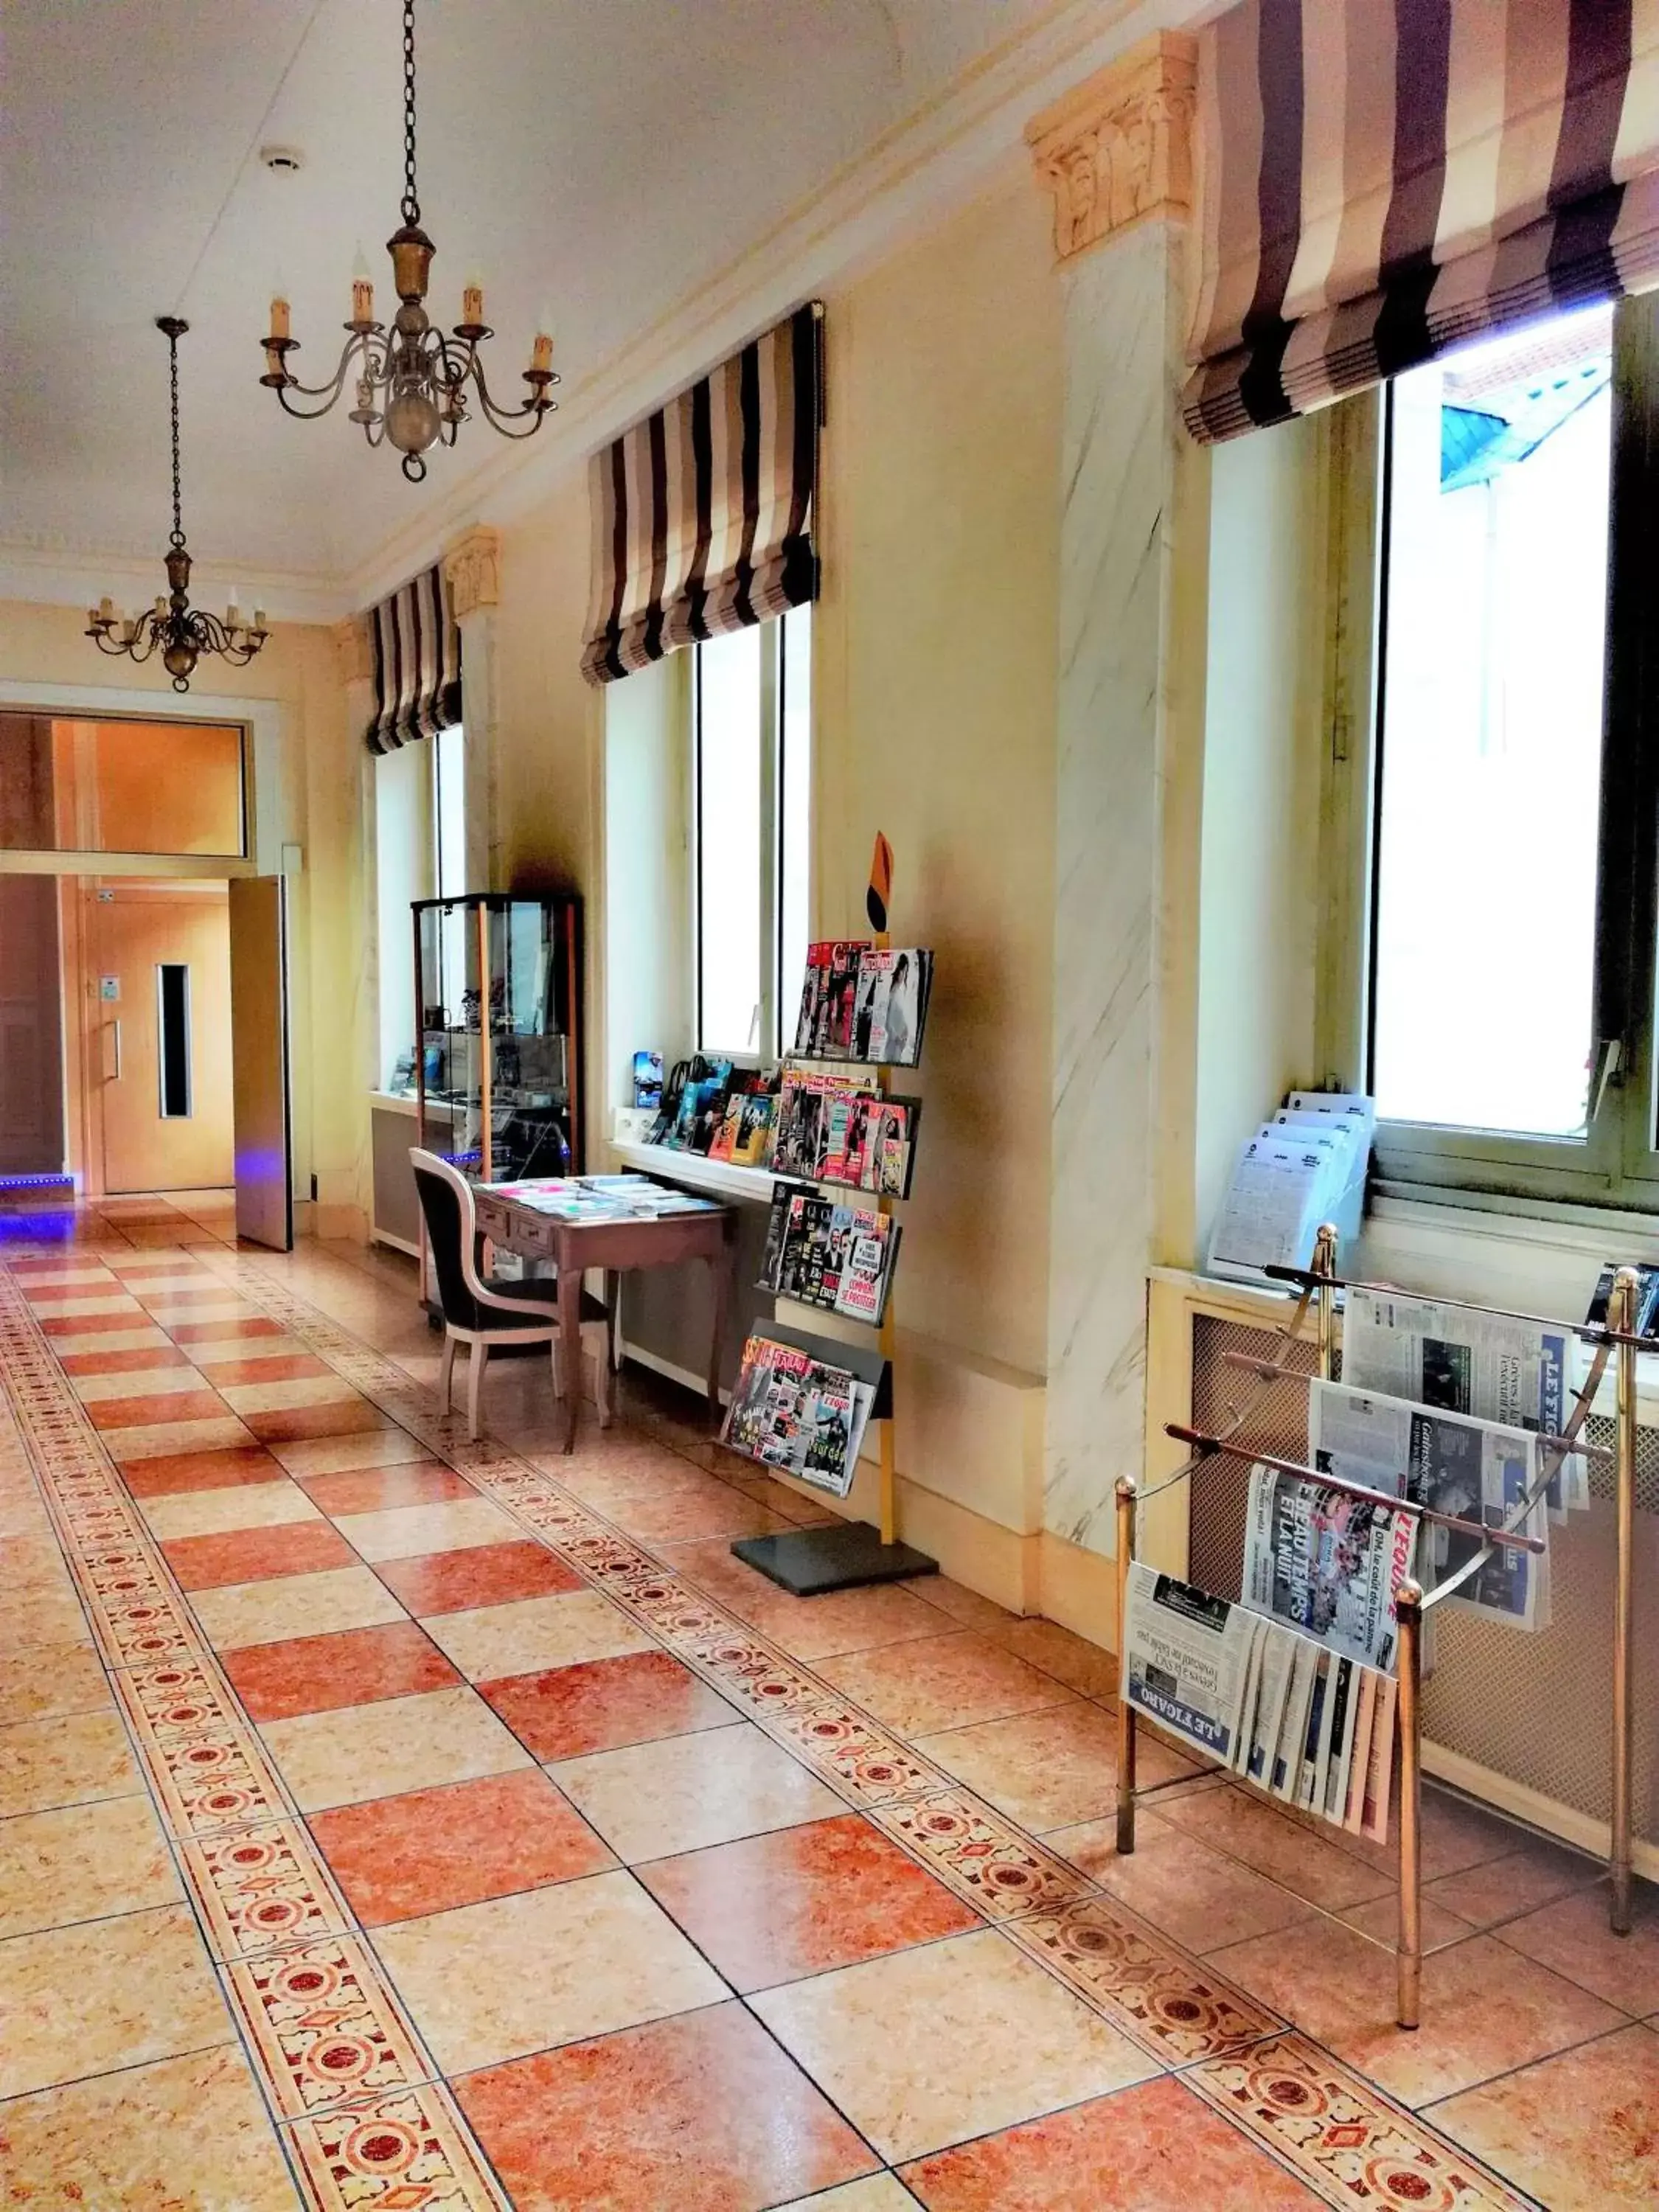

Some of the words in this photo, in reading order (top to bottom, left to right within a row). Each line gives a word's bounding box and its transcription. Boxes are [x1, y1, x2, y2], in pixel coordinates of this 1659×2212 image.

[1545, 1363, 1559, 1393] LE
[1416, 1422, 1433, 1503] Gainsbourg
[1281, 1495, 1295, 1520] ET
[1279, 1519, 1294, 1539] LA
[1293, 1497, 1312, 1555] BEAU
[1374, 1531, 1384, 1552] OM,
[1276, 1542, 1293, 1585] NUIT
[1374, 1554, 1382, 1565] le
[1291, 1554, 1309, 1624] TEMPS
[1371, 1565, 1381, 1590] coût
[1369, 1591, 1378, 1605] de
[1368, 1607, 1377, 1618] la
[1365, 1617, 1375, 1654] panne
[1141, 1688, 1193, 1731] FIGARO
[1194, 1717, 1215, 1740] LE
